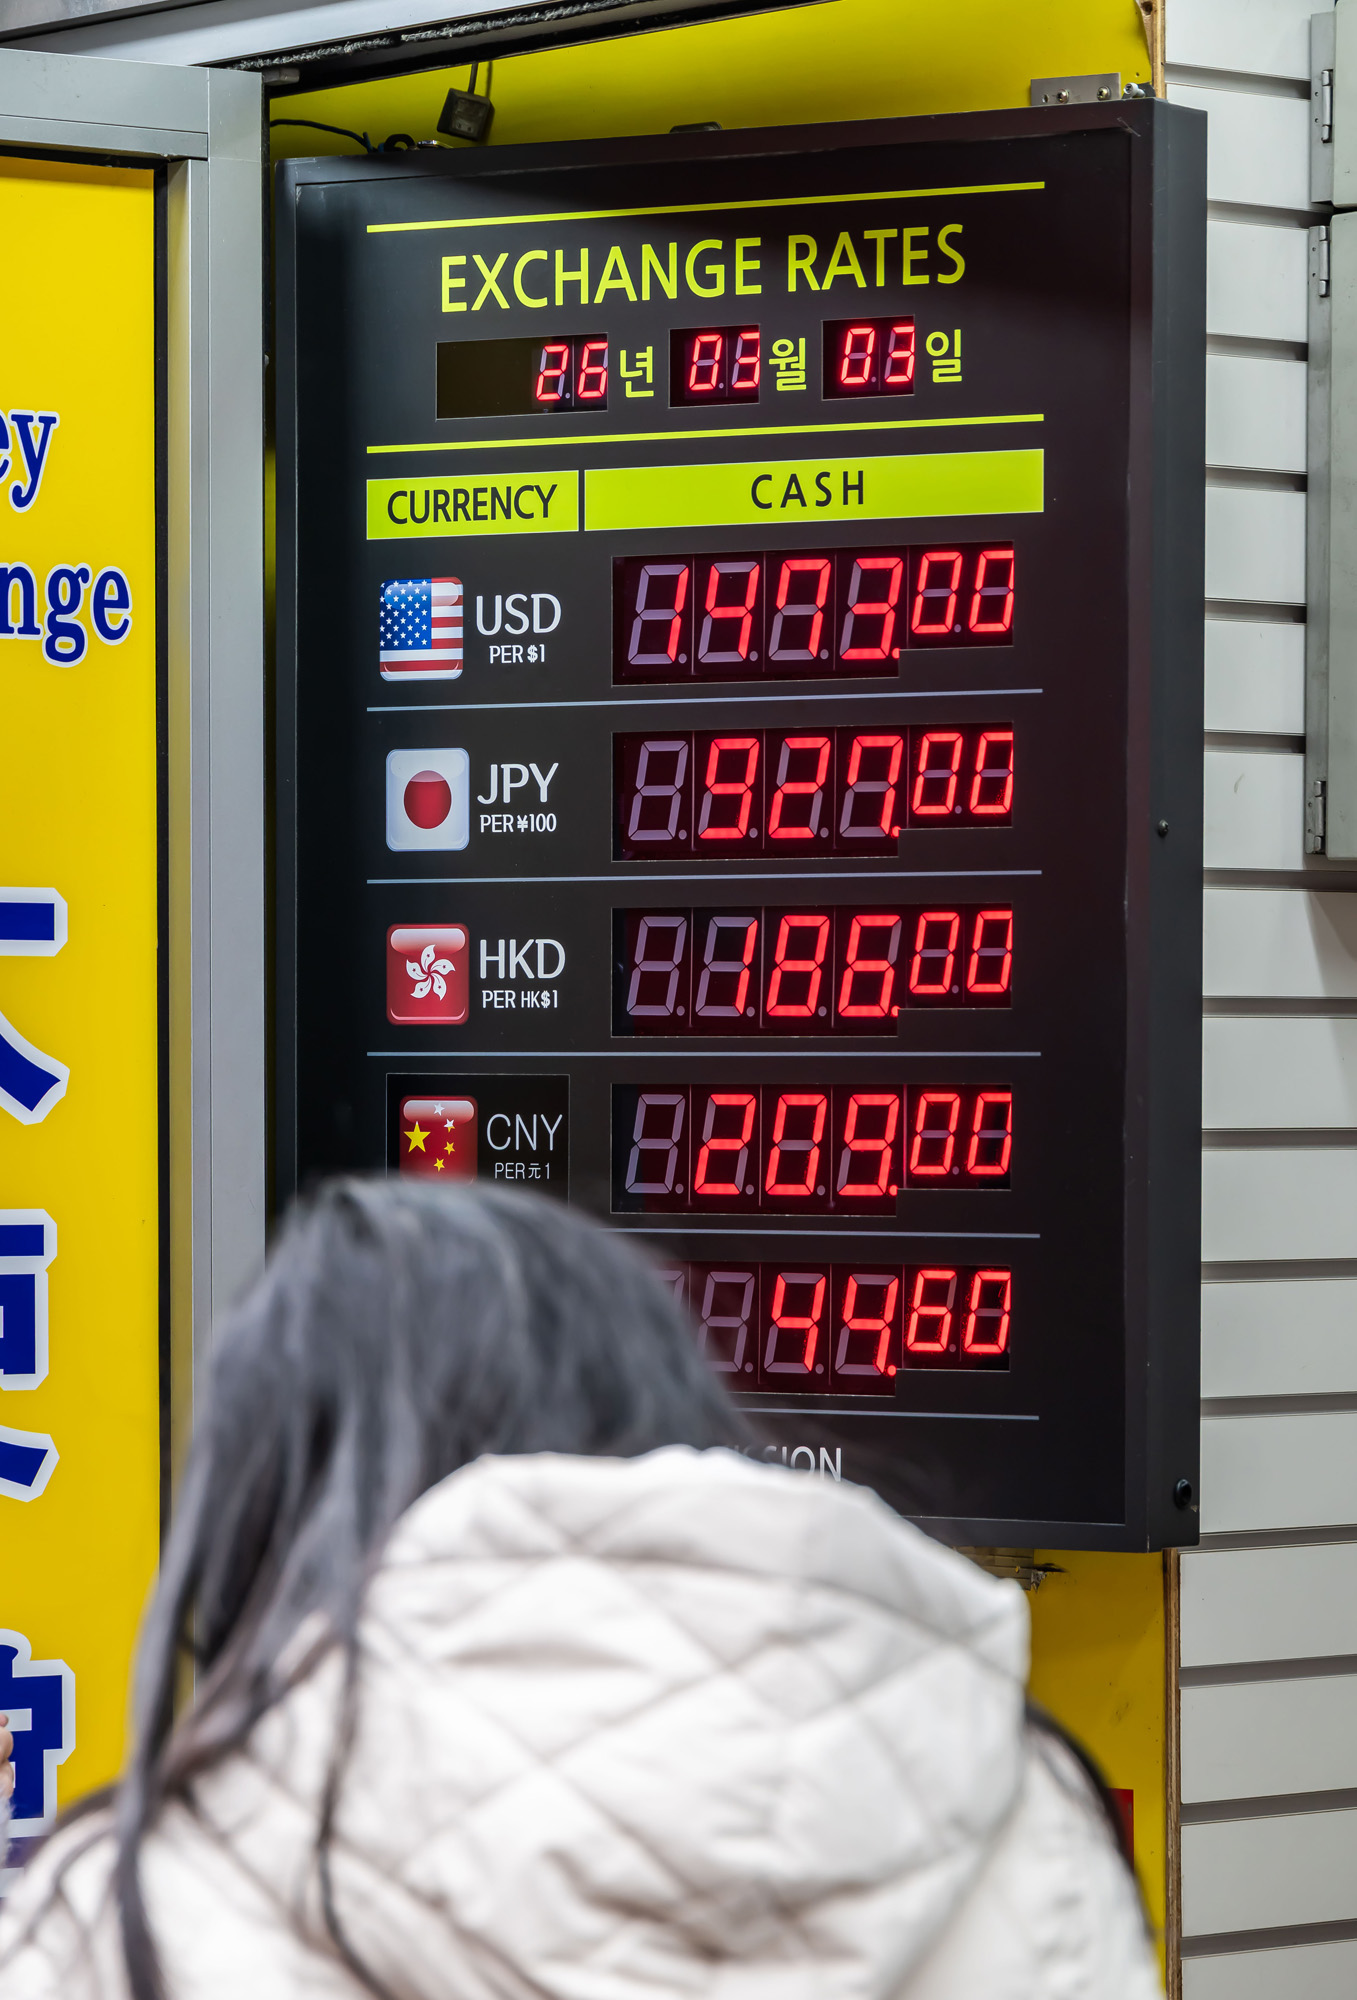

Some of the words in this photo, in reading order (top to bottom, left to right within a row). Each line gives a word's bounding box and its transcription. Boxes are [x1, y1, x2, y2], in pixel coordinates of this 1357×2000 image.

[439, 237, 762, 313] EXCHANGE
[787, 223, 965, 293] RATES
[536, 341, 608, 401] 26
[619, 345, 654, 398] 년
[768, 337, 807, 391] 월
[840, 325, 915, 384] 03
[925, 328, 962, 383] 일
[387, 484, 558, 525] CURRENCY
[750, 470, 865, 510] CASH
[476, 593, 562, 636] USD
[489, 644, 524, 664] PER
[526, 643, 545, 664] $1
[476, 762, 559, 805] JPY
[479, 813, 514, 833] PER
[516, 812, 557, 833] ¥100
[479, 938, 566, 980] HKD
[482, 989, 517, 1009] PER
[520, 989, 558, 1009] HK$1
[486, 1113, 563, 1151] CNY
